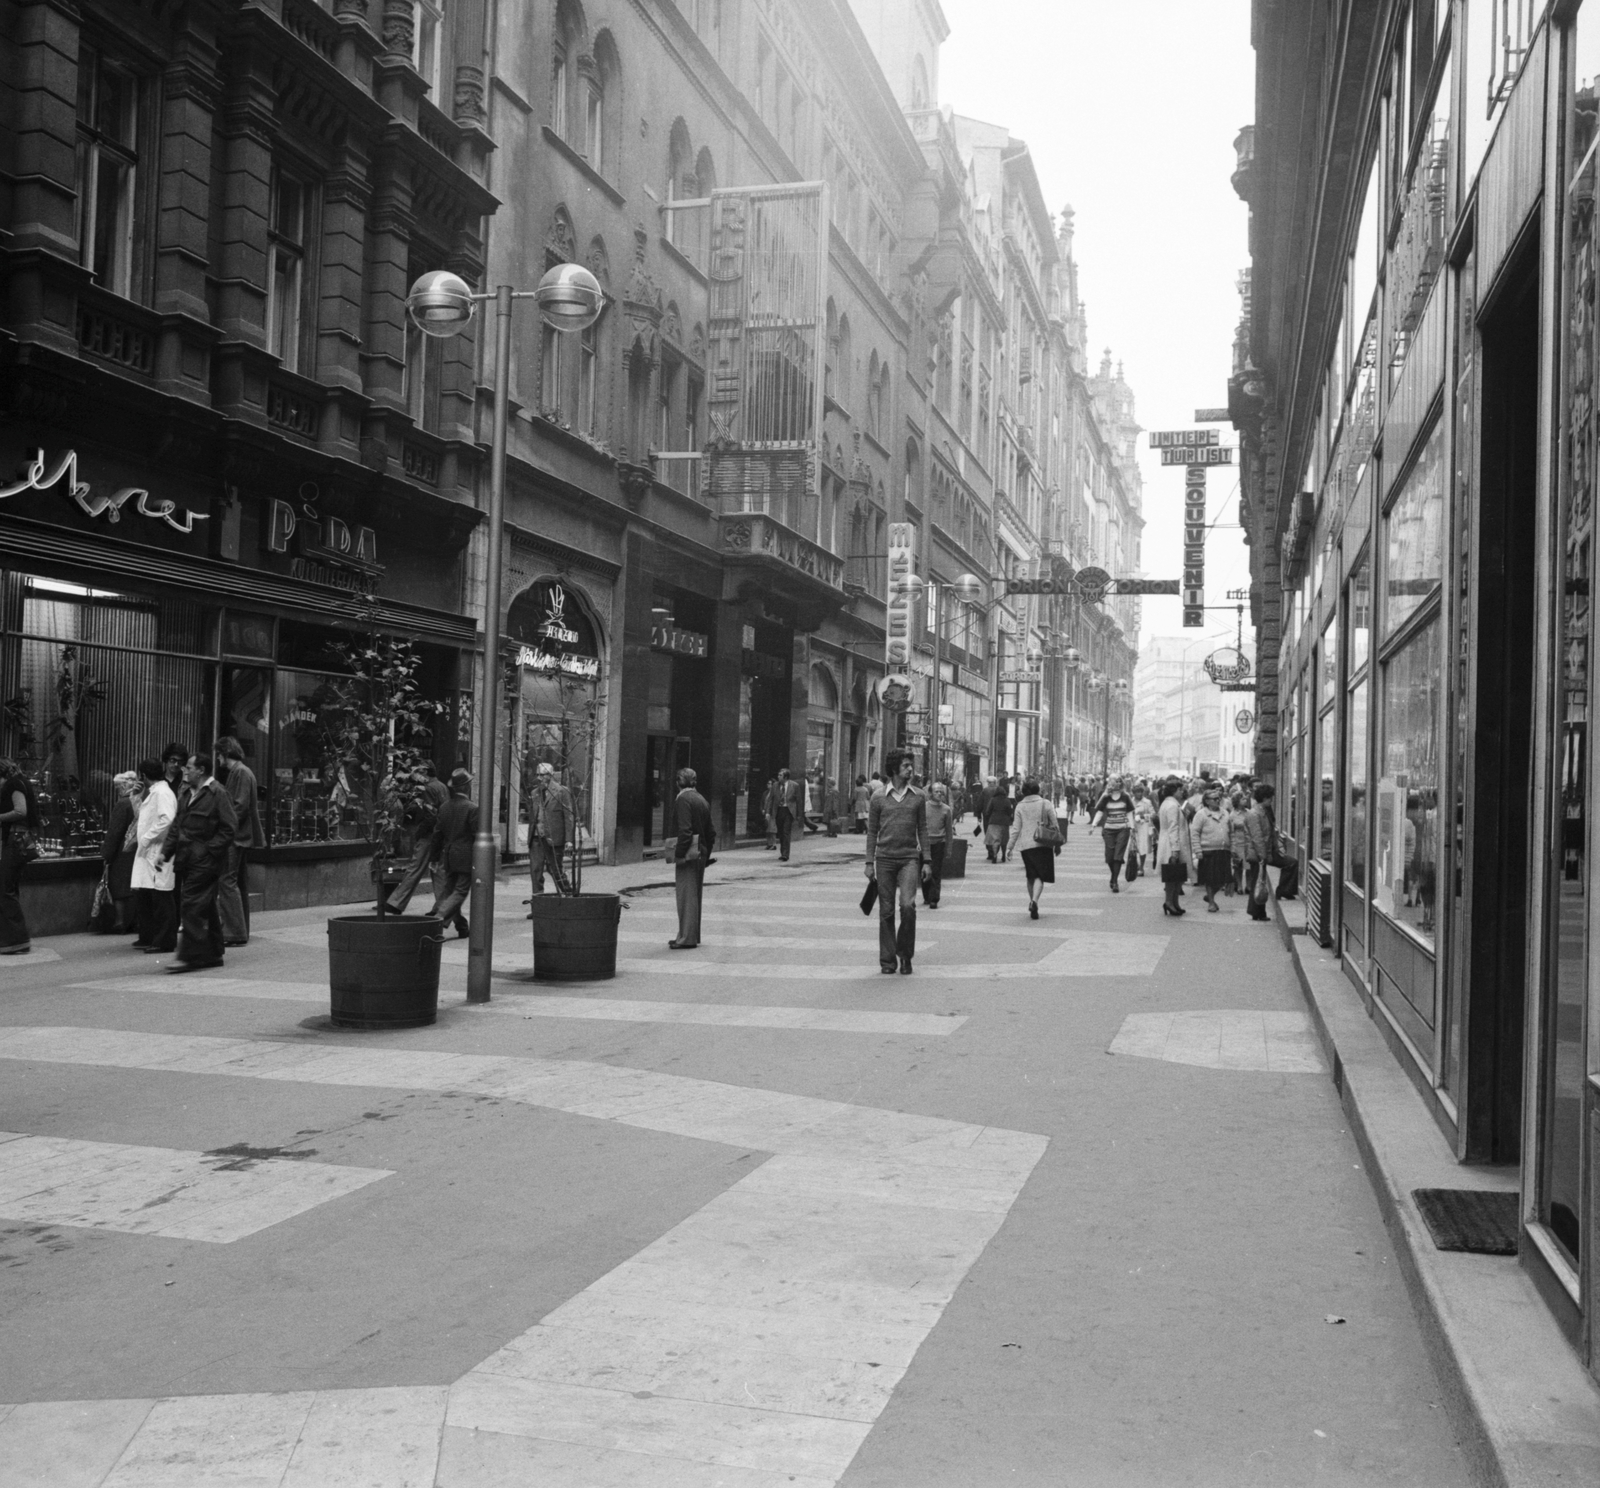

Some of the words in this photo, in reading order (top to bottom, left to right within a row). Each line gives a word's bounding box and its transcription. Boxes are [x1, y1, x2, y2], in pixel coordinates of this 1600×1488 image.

[1151, 430, 1218, 447] INTER-
[1162, 448, 1231, 464] TURIST
[1184, 468, 1206, 625] SOUVENIR
[888, 523, 912, 665] MÉZES
[1007, 578, 1066, 594] ORION
[1116, 578, 1179, 594] ORION
[278, 708, 318, 731] AJÁNDÉK
